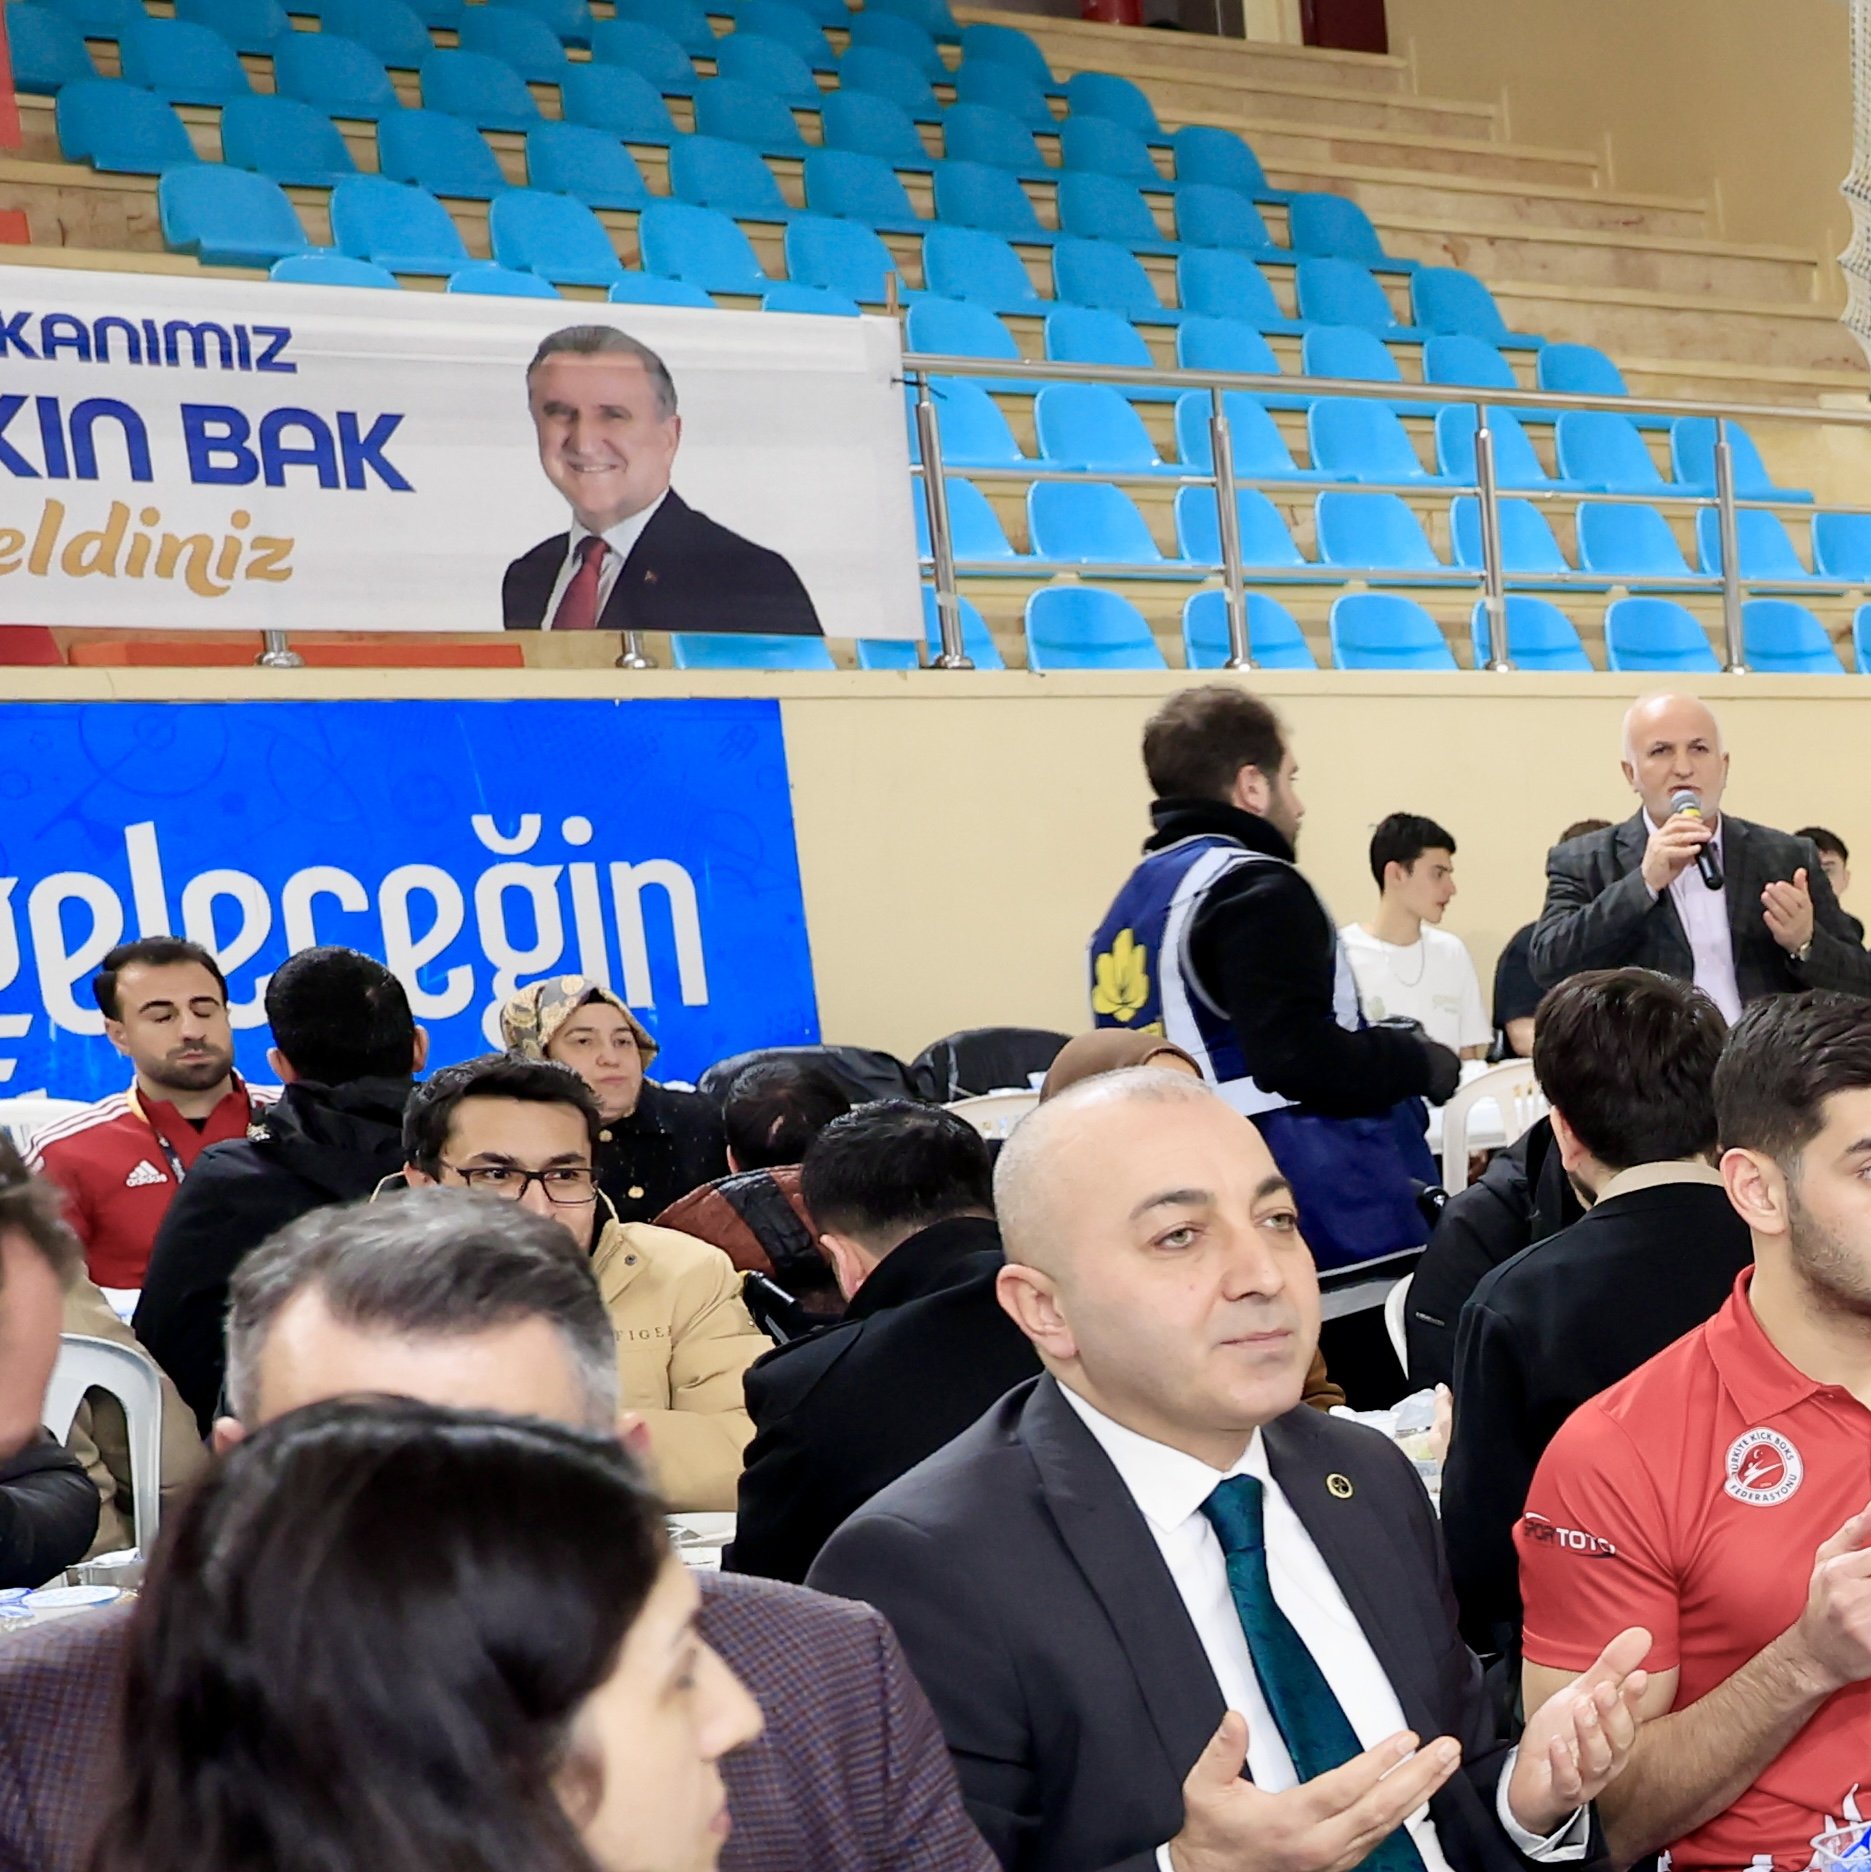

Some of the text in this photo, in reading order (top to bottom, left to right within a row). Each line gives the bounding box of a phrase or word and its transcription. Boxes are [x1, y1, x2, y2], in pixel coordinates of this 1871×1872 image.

[180, 402, 417, 493] BAK
[0, 813, 709, 1052] eleceğin
[1729, 1474, 1798, 1501] FEDERASYONU
